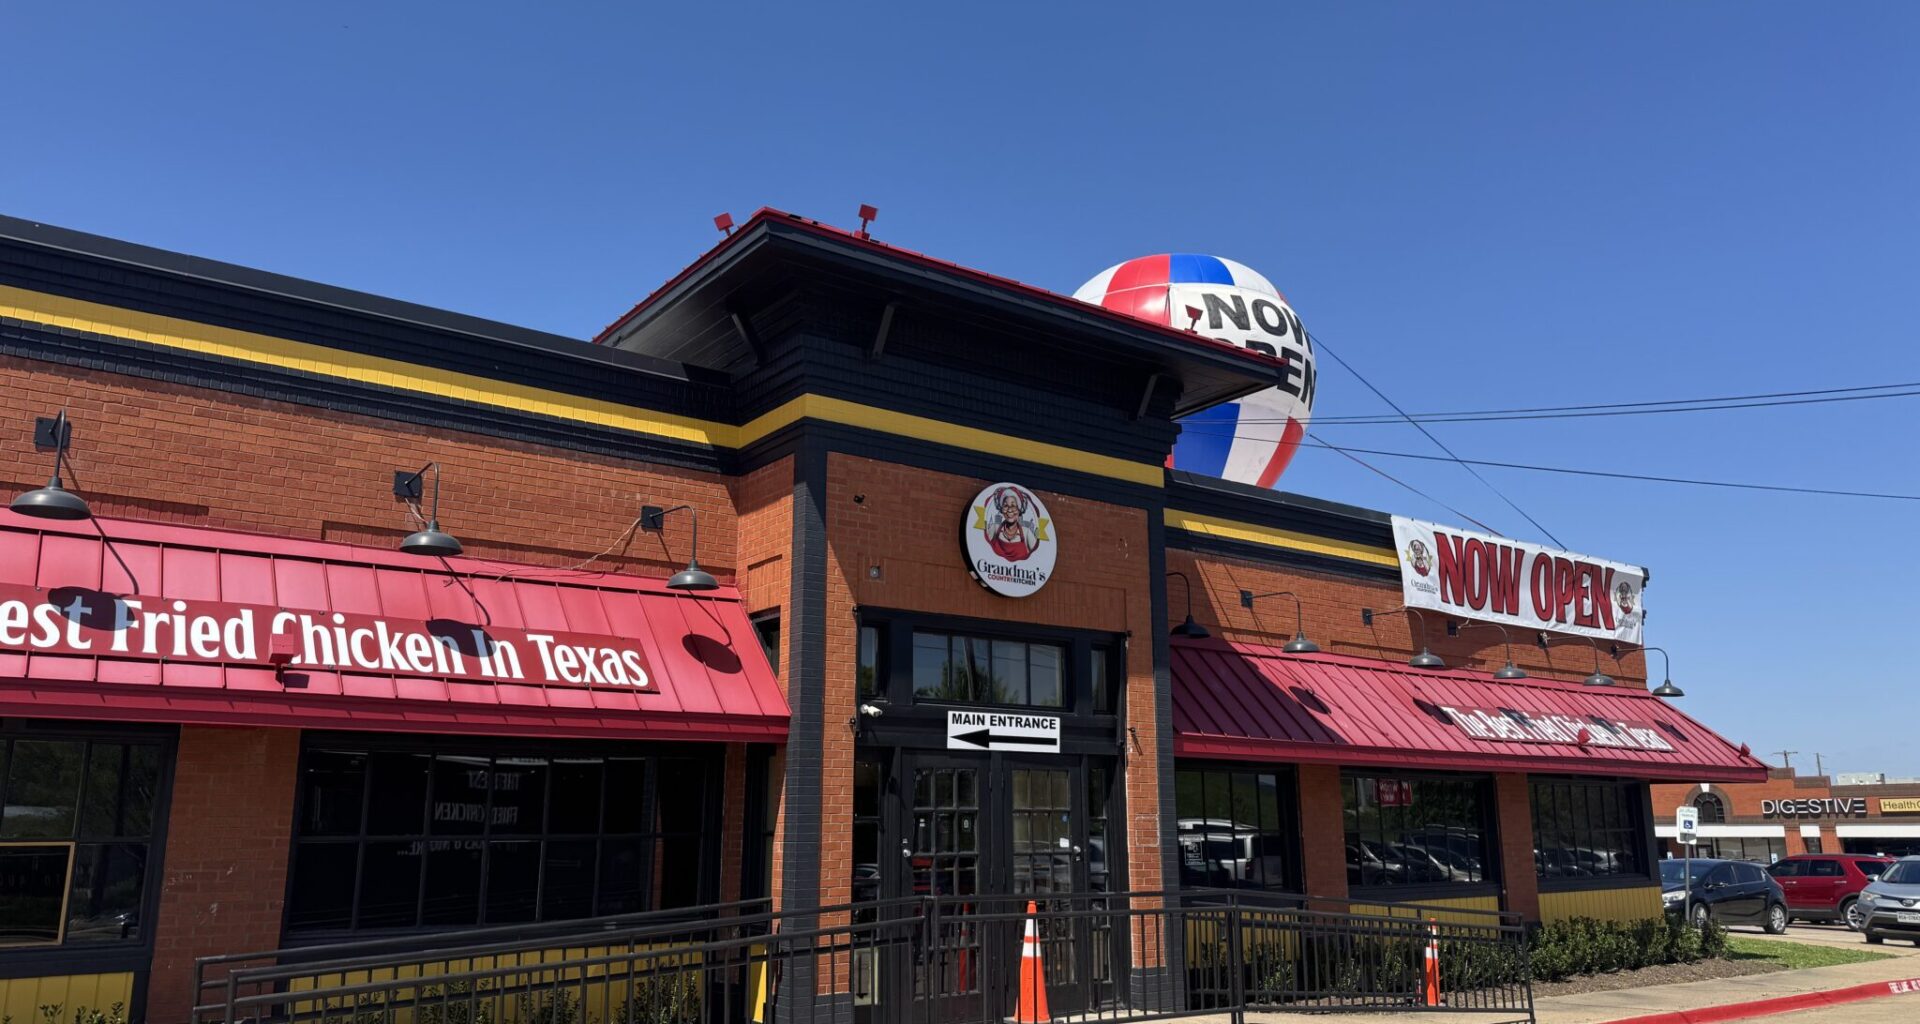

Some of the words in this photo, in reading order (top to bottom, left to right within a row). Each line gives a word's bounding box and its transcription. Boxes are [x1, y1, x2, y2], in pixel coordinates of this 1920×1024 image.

[977, 559, 1046, 581] Grandma's
[1433, 531, 1525, 616] NOW
[1530, 552, 1615, 631] OPEN
[0, 596, 92, 651] est
[111, 598, 253, 660] Fried
[476, 627, 525, 680] In
[527, 634, 649, 688] Texas
[951, 713, 986, 726] MAIN
[989, 715, 1057, 730] ENTRANCE
[1761, 797, 1867, 815] DIGESTIVE
